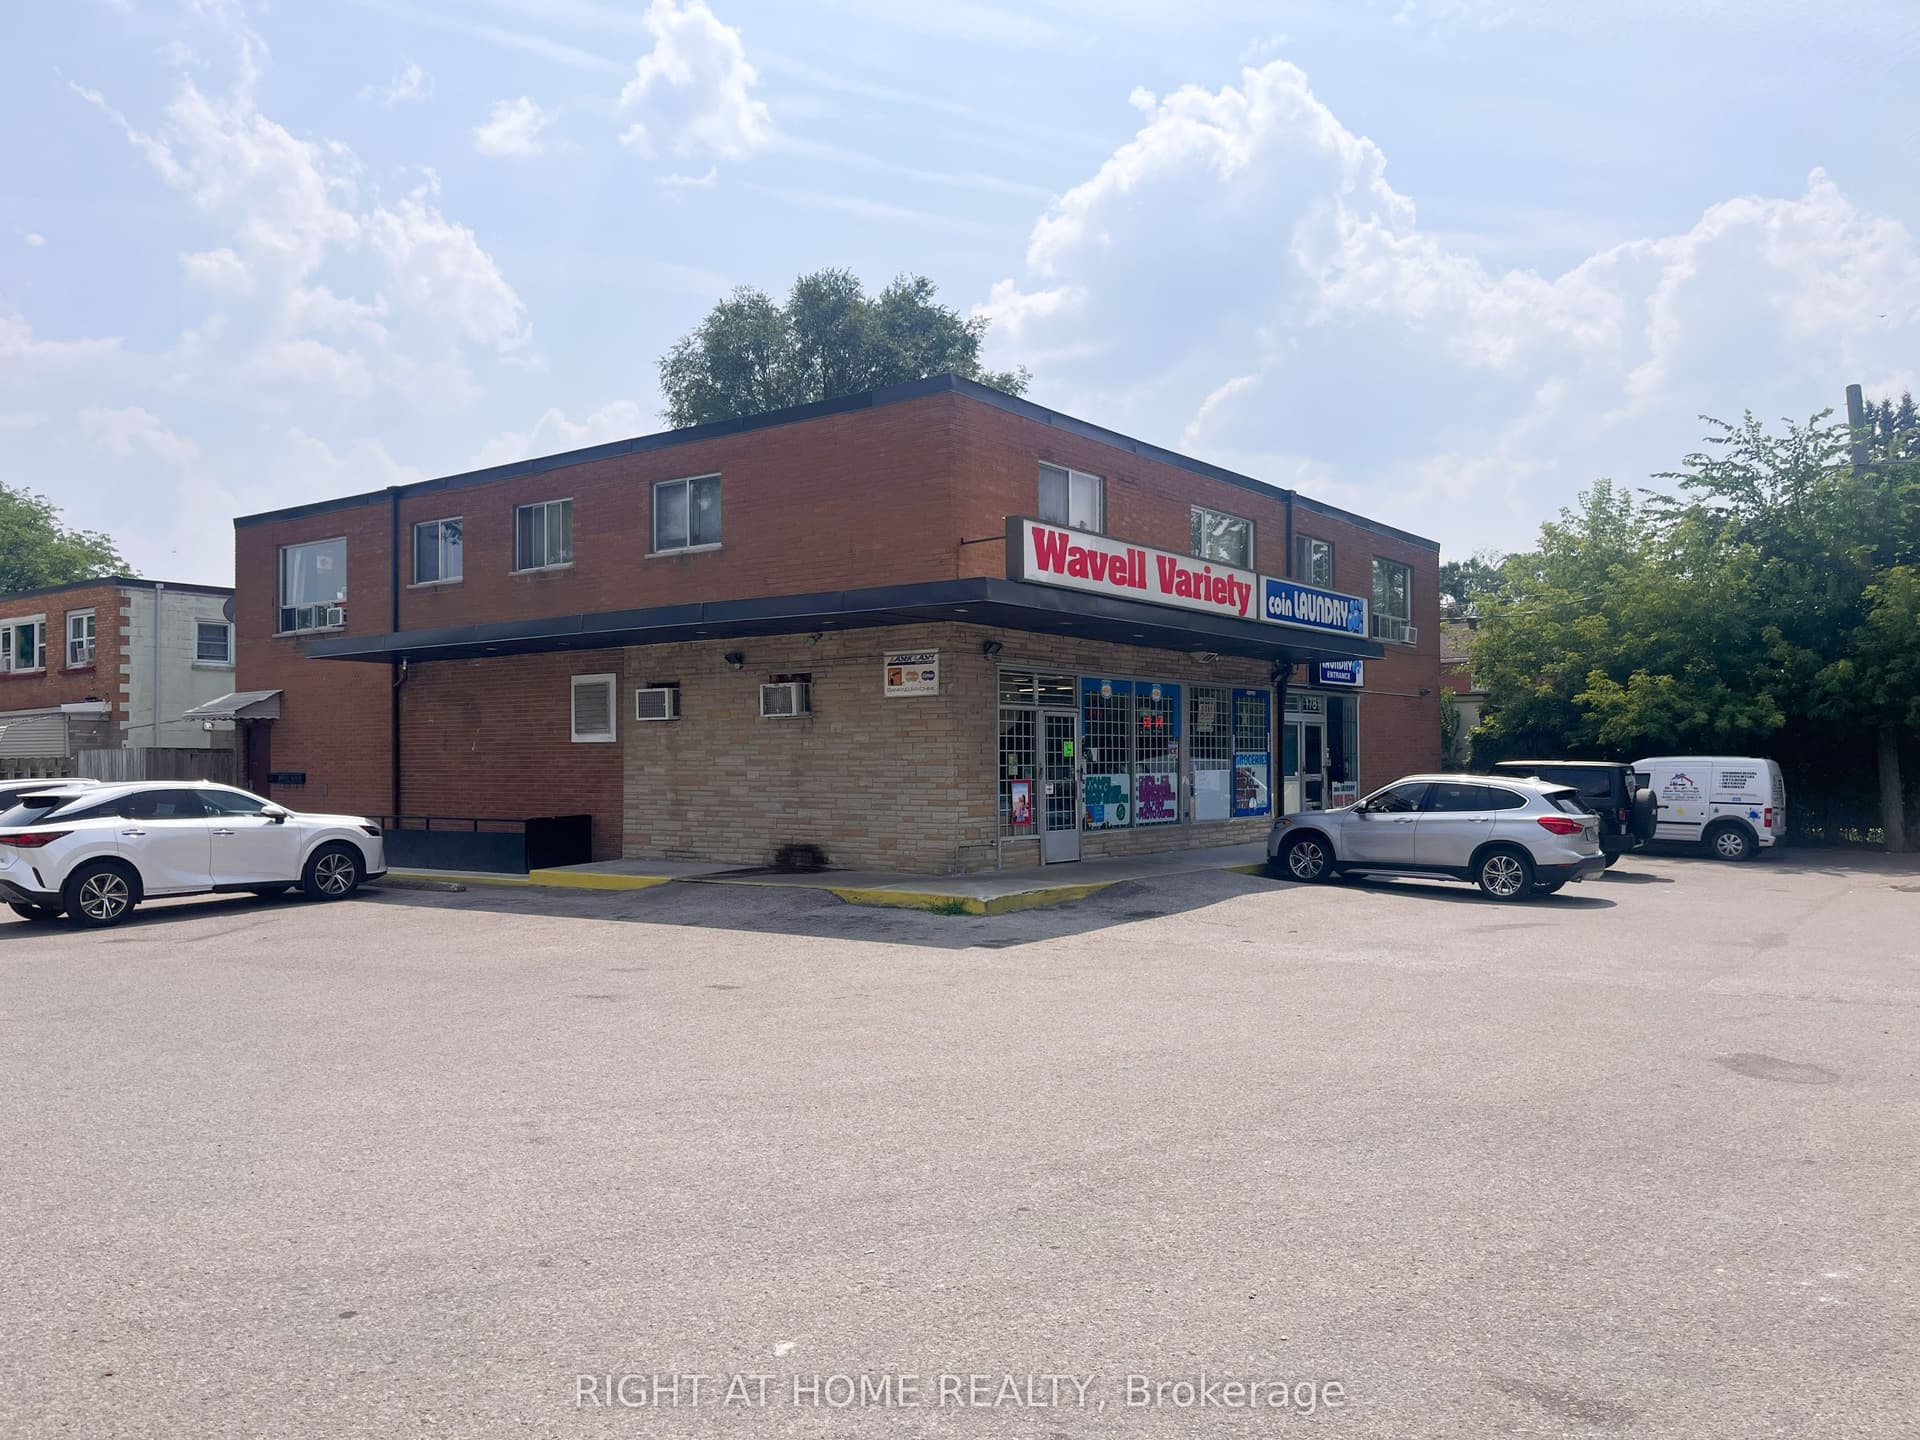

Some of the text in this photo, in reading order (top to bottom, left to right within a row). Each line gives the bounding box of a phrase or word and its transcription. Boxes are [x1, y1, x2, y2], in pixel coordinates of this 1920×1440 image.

[1032, 526, 1252, 617] Wavell Variety
[1268, 591, 1349, 627] coin LAUNDRY
[1327, 671, 1351, 680] ENTRANCE
